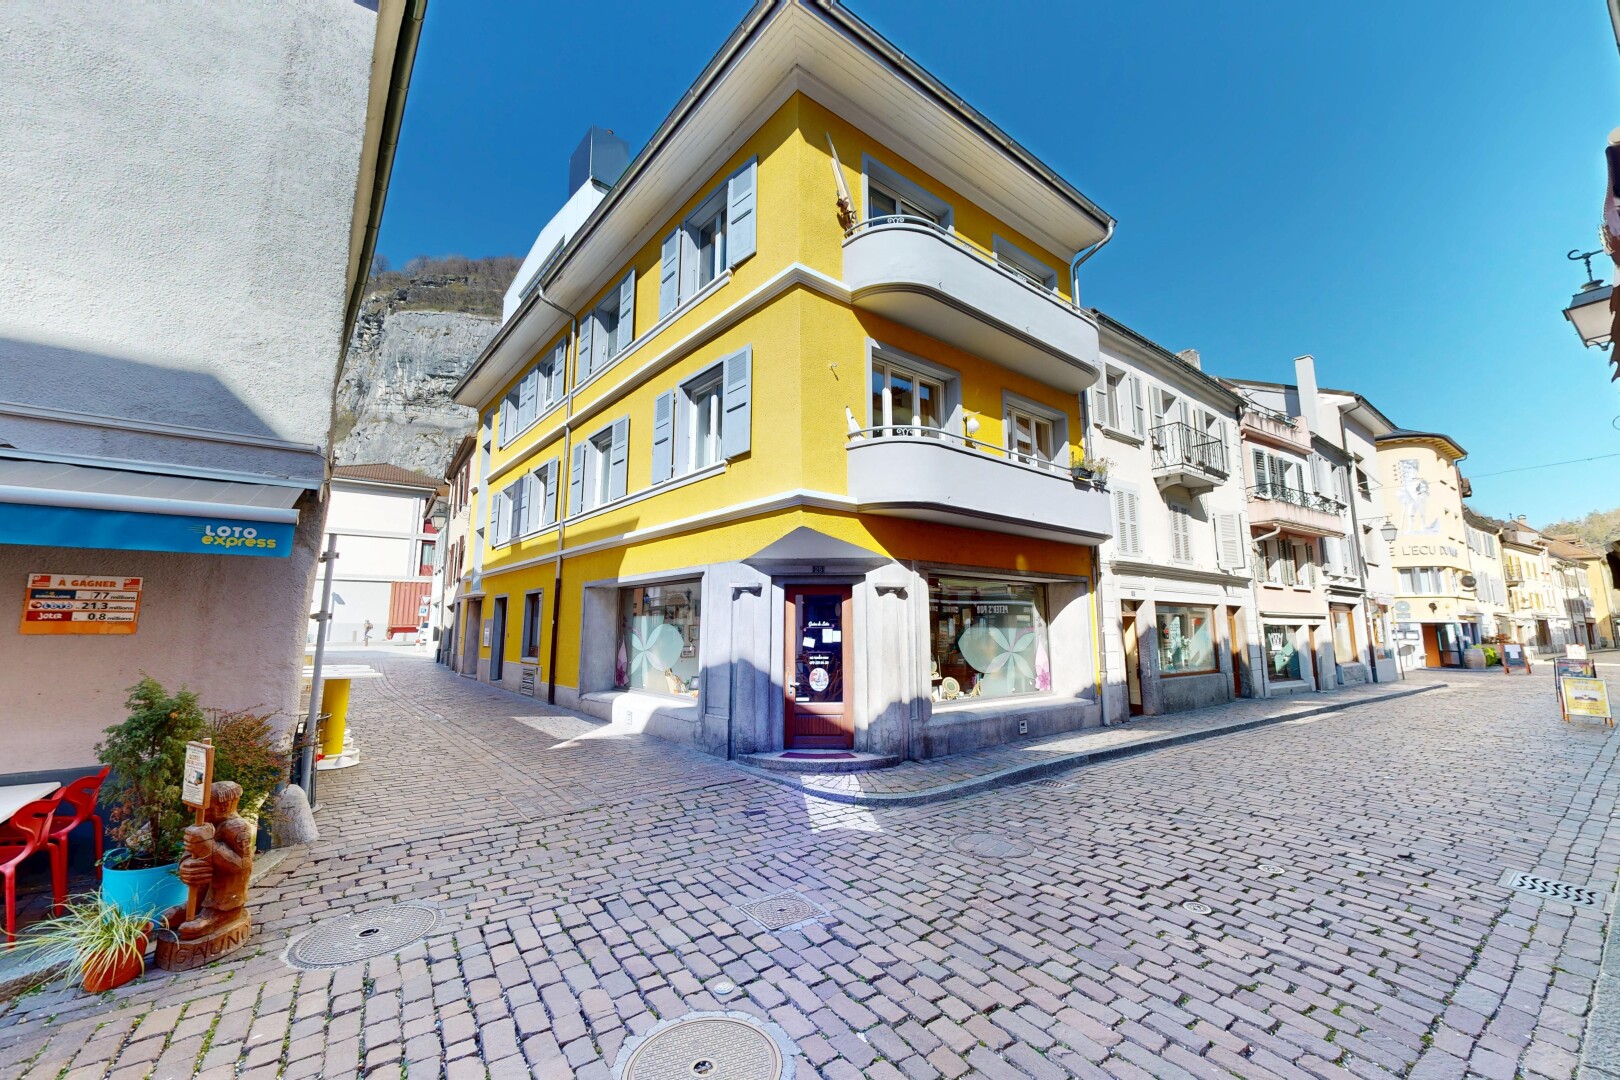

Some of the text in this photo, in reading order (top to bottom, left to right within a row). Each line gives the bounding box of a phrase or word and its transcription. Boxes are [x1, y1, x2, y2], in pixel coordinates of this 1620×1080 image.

[205, 525, 257, 538] LOTO
[201, 535, 276, 548] express
[71, 579, 117, 588] GAGNER
[93, 591, 110, 599] 77
[37, 612, 63, 620] JOKER
